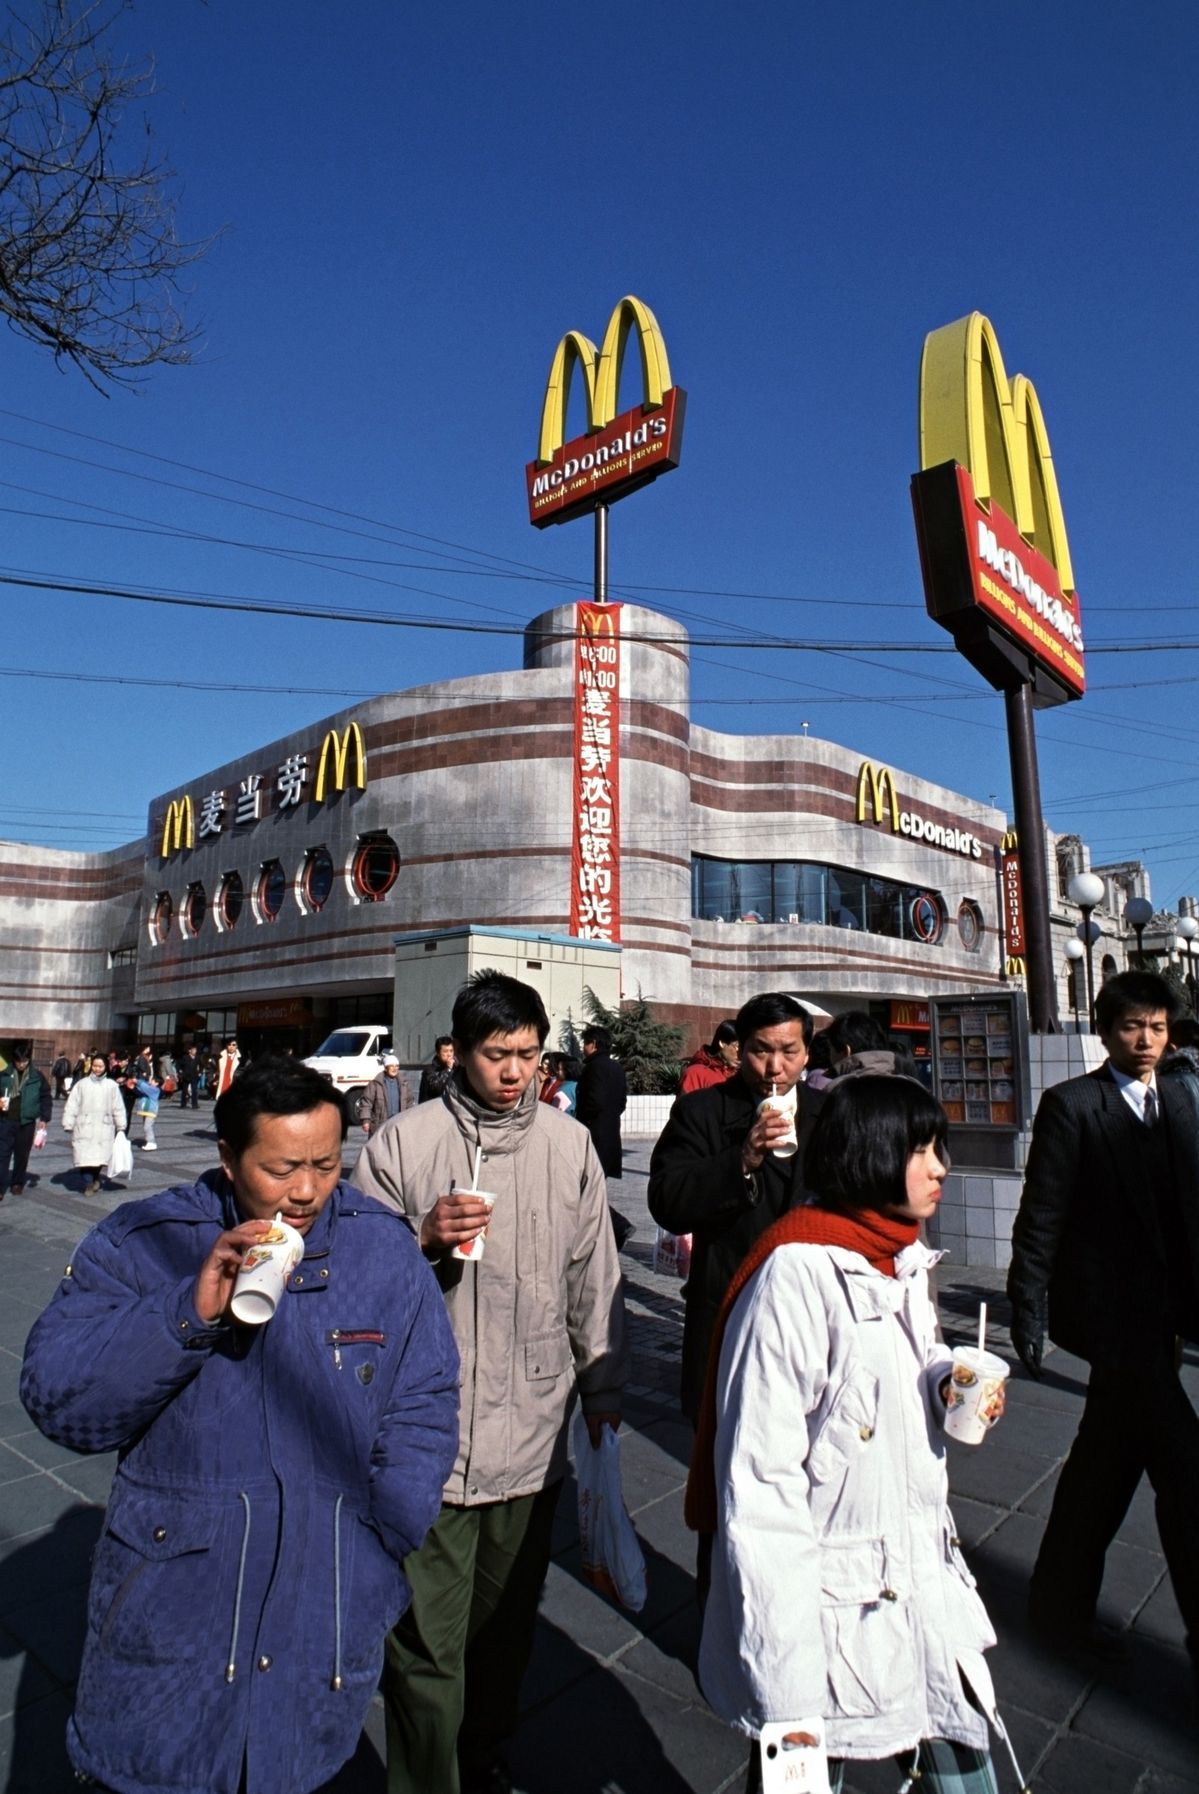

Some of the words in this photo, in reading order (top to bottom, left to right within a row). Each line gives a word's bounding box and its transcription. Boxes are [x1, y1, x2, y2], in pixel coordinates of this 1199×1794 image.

[532, 417, 667, 497] McDonald's
[199, 754, 309, 839] 麦当劳
[1006, 861, 1021, 947] McDonald's
